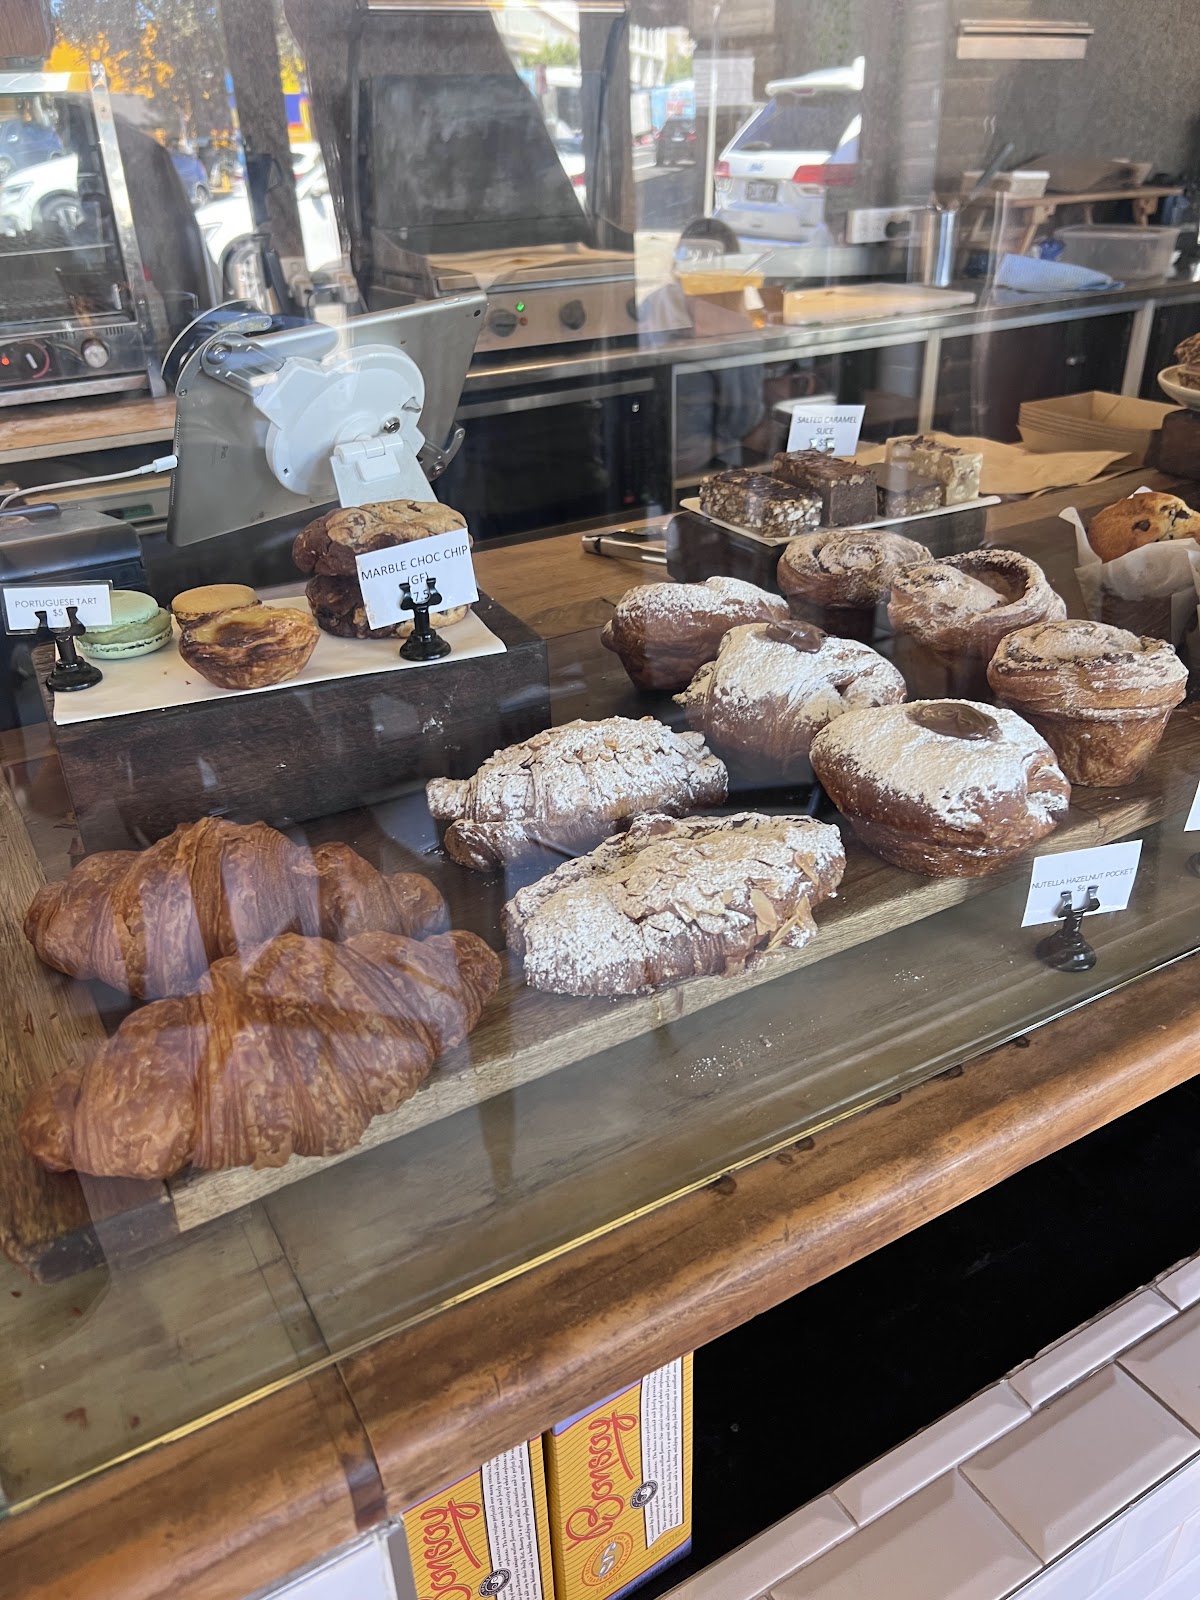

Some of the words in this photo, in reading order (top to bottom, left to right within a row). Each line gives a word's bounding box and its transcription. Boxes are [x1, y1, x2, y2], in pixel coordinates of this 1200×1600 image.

[797, 416, 823, 424] SALTED
[824, 416, 857, 424] CARAMEL
[816, 427, 834, 435] SLICE
[361, 560, 408, 581] MARBLE
[410, 551, 441, 568] CHOC
[443, 544, 468, 559] CHIP
[413, 589, 430, 602] 7.5
[15, 598, 75, 608] PORTUGUESE
[76, 597, 97, 606] TART
[53, 608, 64, 617] $5
[1031, 879, 1065, 890] NUTELLA
[1066, 873, 1105, 885] HAZELNUT
[1105, 867, 1134, 879] POCKET
[565, 1411, 638, 1552] Bonsoy
